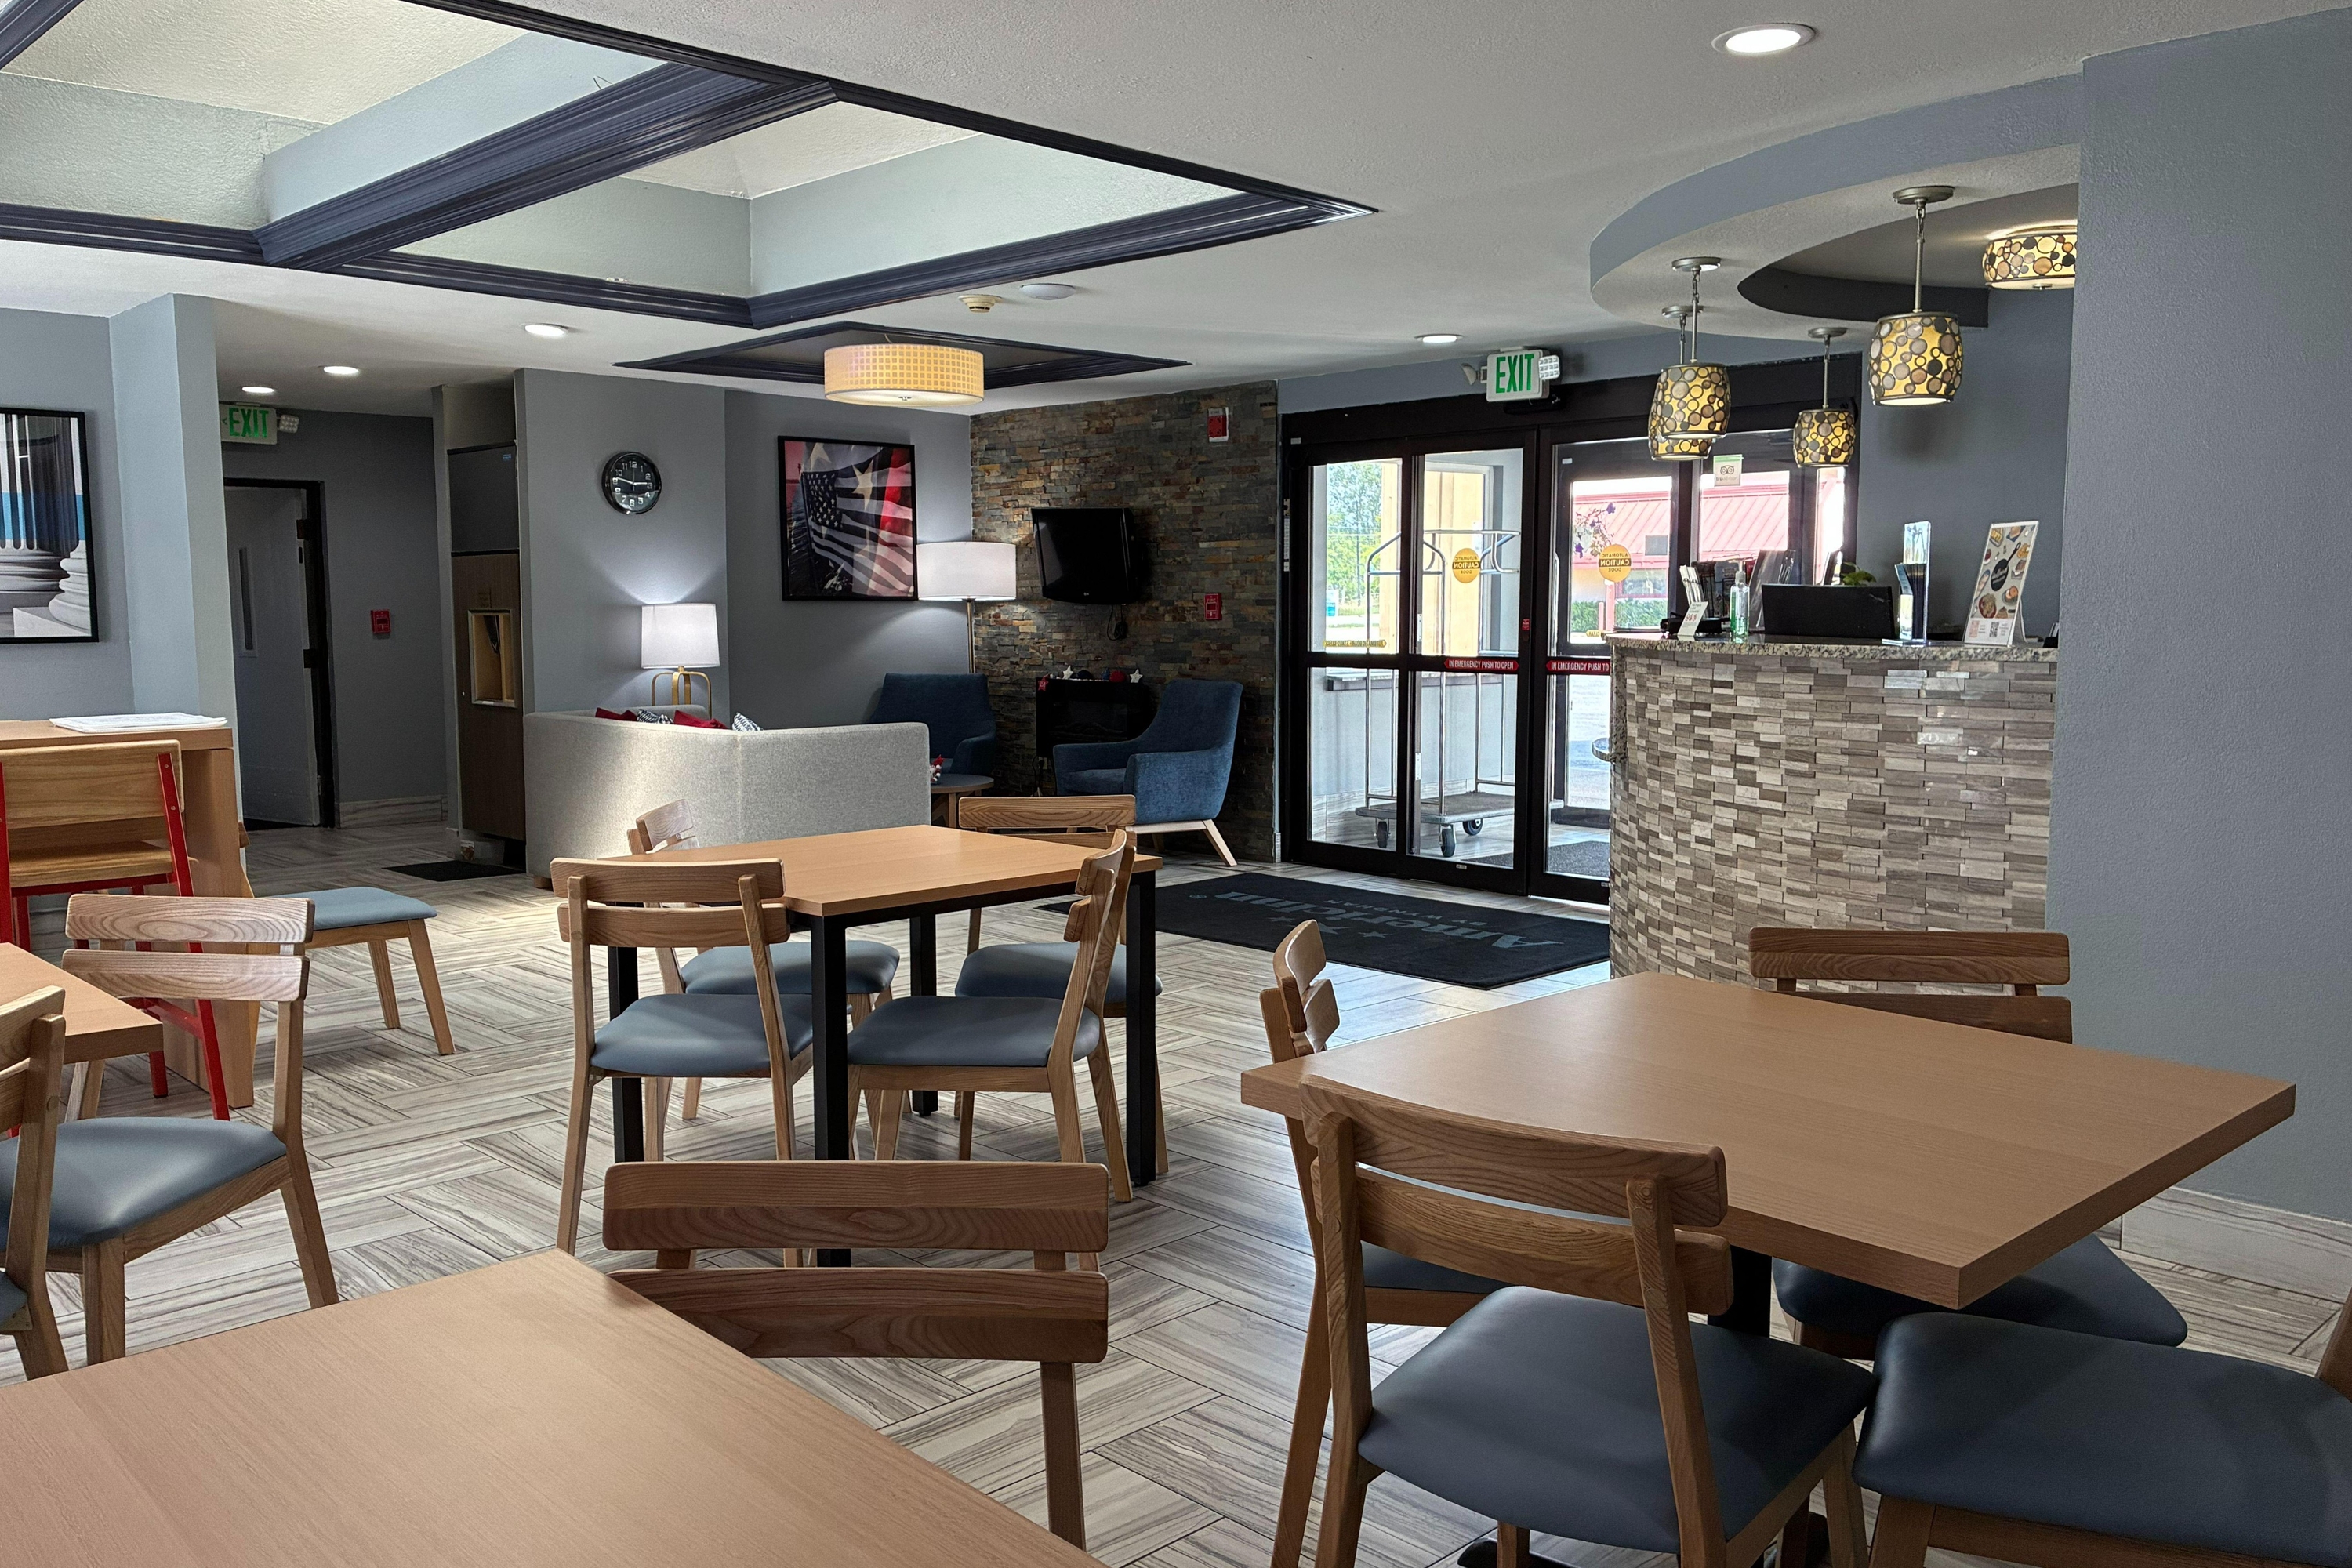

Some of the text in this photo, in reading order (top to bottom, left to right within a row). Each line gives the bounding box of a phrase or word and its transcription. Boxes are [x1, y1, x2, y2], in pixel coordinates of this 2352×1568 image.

[1495, 353, 1535, 394] EXIT
[228, 407, 269, 438] EXIT
[1557, 662, 1587, 671] EMERGENCY
[1588, 662, 1601, 671] PUSH
[1324, 899, 1442, 920] WYNDHAM
